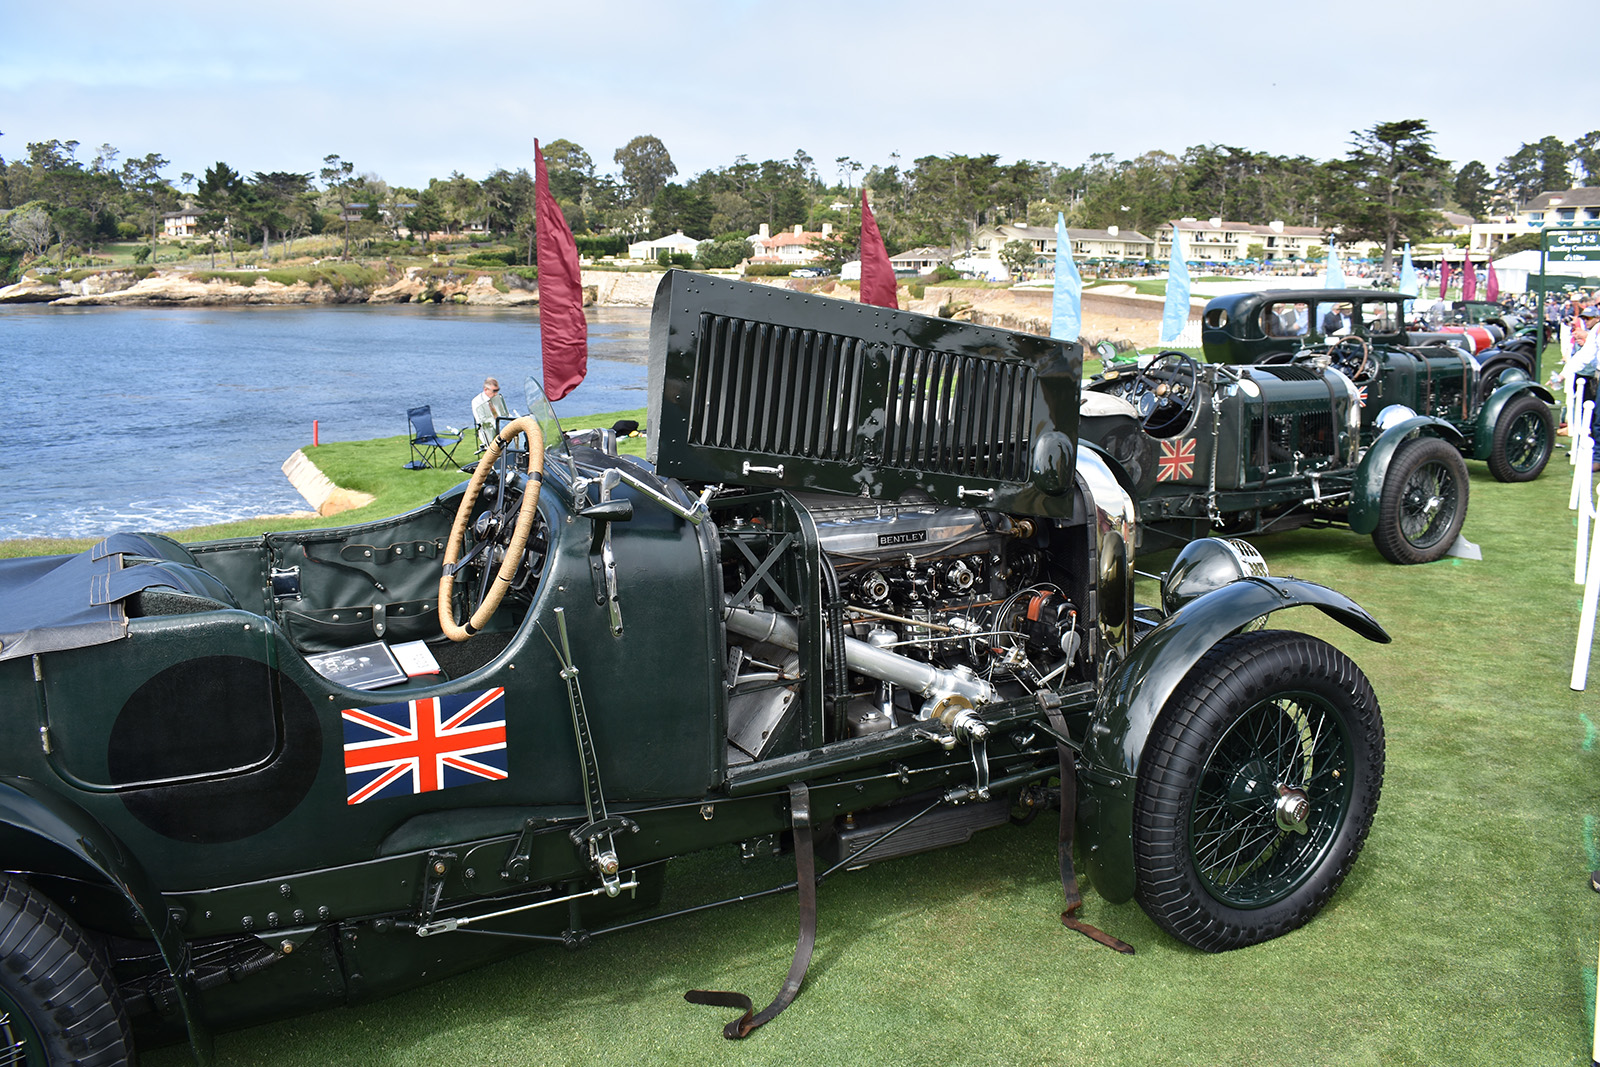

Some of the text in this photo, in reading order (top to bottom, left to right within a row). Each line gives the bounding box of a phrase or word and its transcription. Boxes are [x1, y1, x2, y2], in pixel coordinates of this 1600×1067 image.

[1558, 235, 1597, 244] Class F-2
[880, 532, 924, 545] BENTLEY
